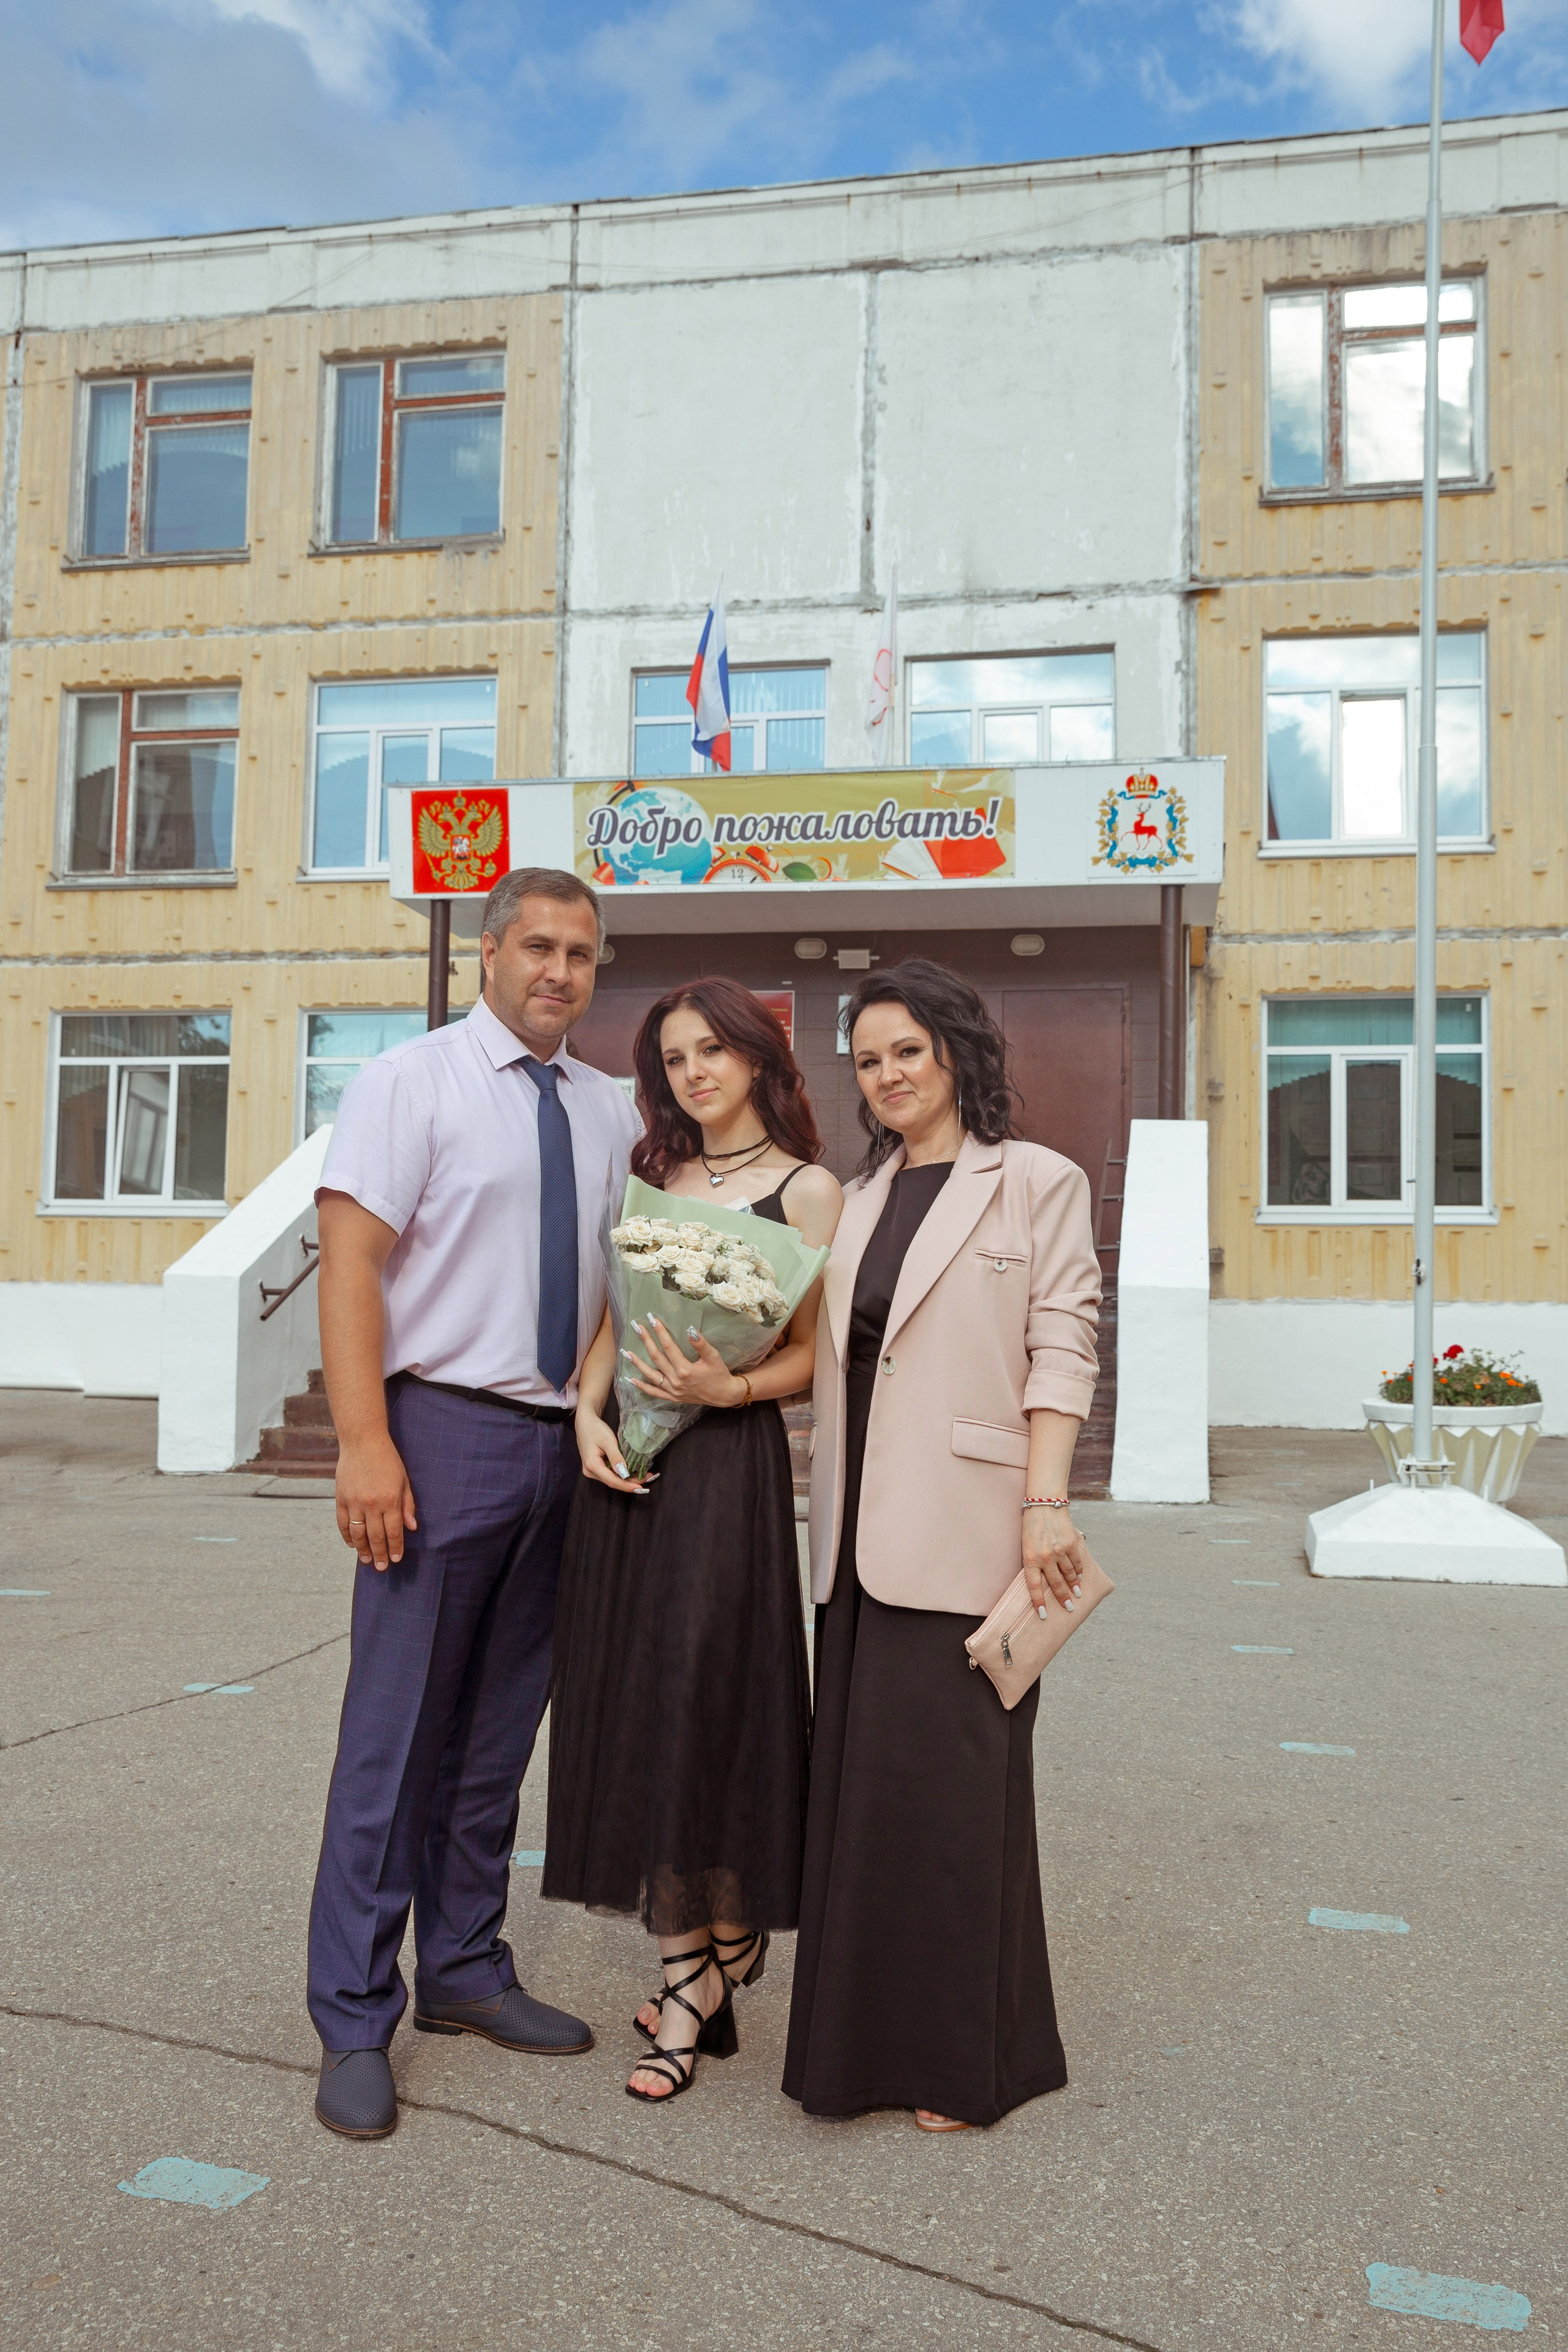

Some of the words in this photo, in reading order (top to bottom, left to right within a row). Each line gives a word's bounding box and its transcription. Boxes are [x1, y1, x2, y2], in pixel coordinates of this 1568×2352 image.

[587, 805, 703, 856] Добро
[713, 799, 1000, 843] пожаловать!
[731, 869, 744, 878] 12
